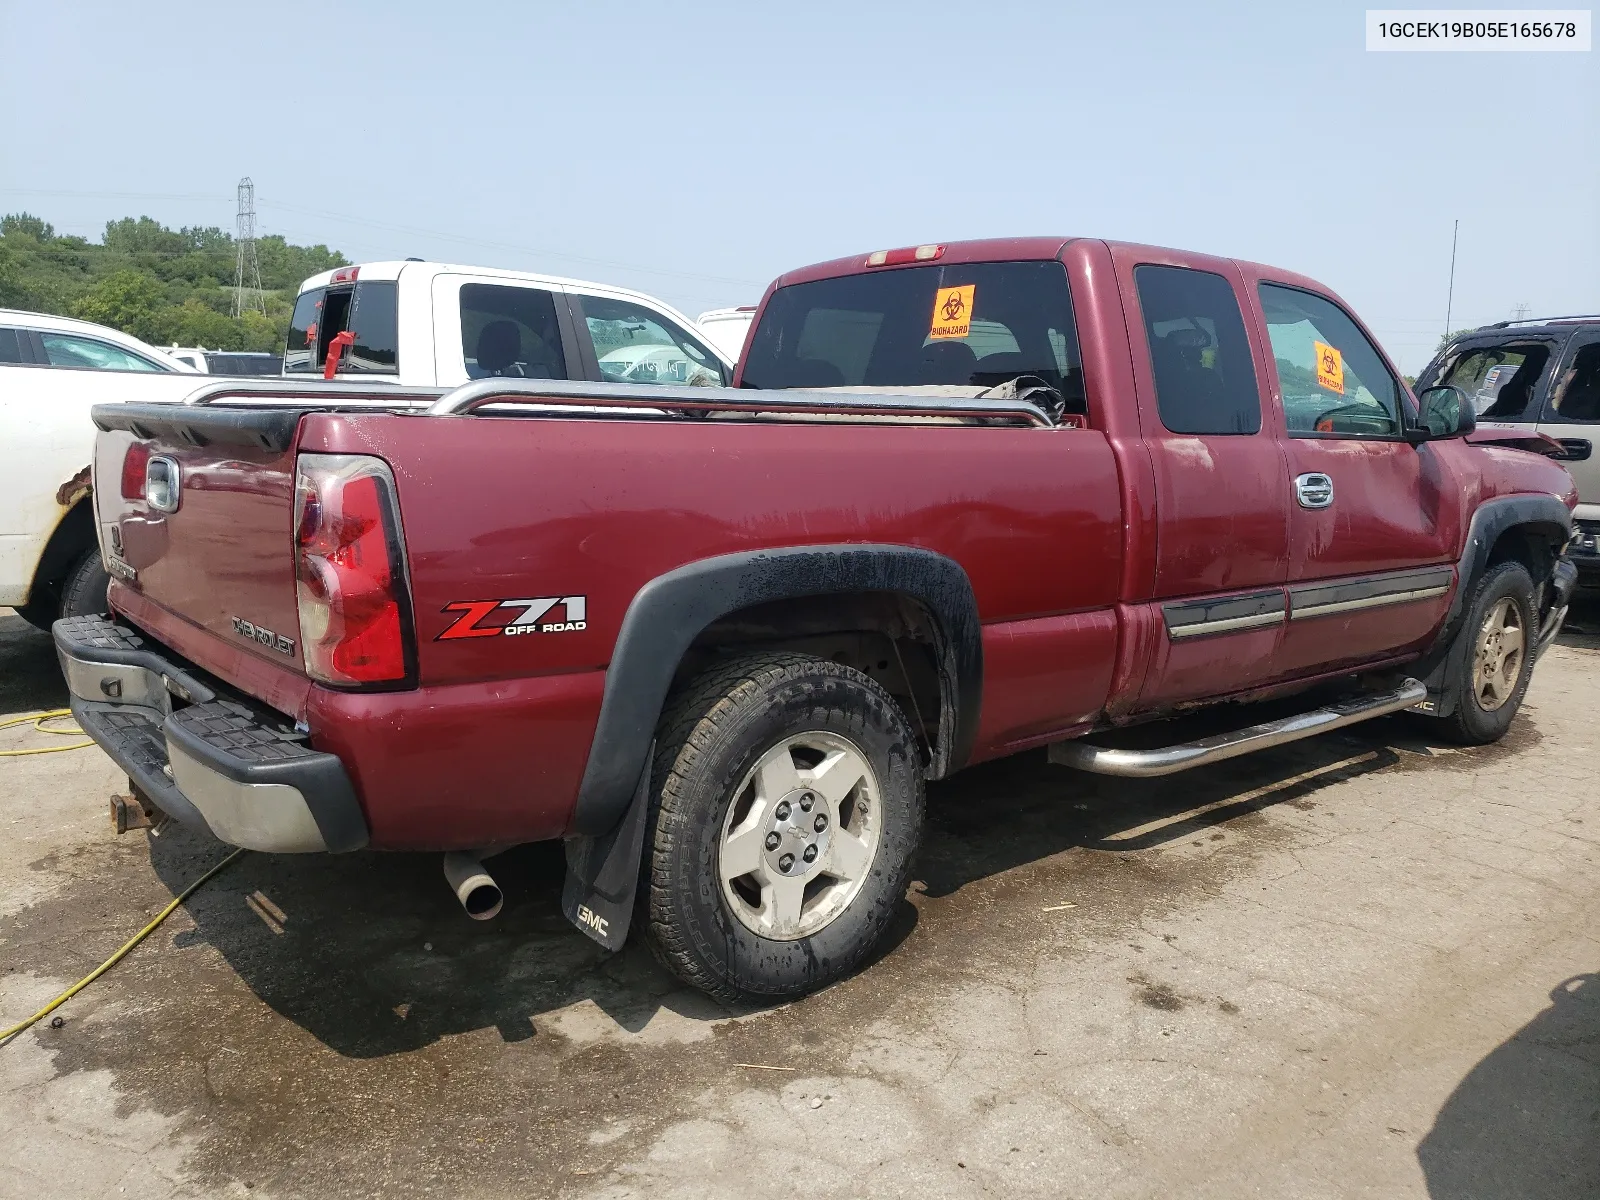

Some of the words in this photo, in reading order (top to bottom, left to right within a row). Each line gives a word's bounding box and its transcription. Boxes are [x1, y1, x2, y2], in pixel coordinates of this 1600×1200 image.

[931, 325, 968, 336] BIOHAZARD
[434, 596, 587, 641] Z71
[504, 624, 536, 636] OFF
[543, 621, 587, 633] ROAD
[576, 903, 609, 937] GMC
